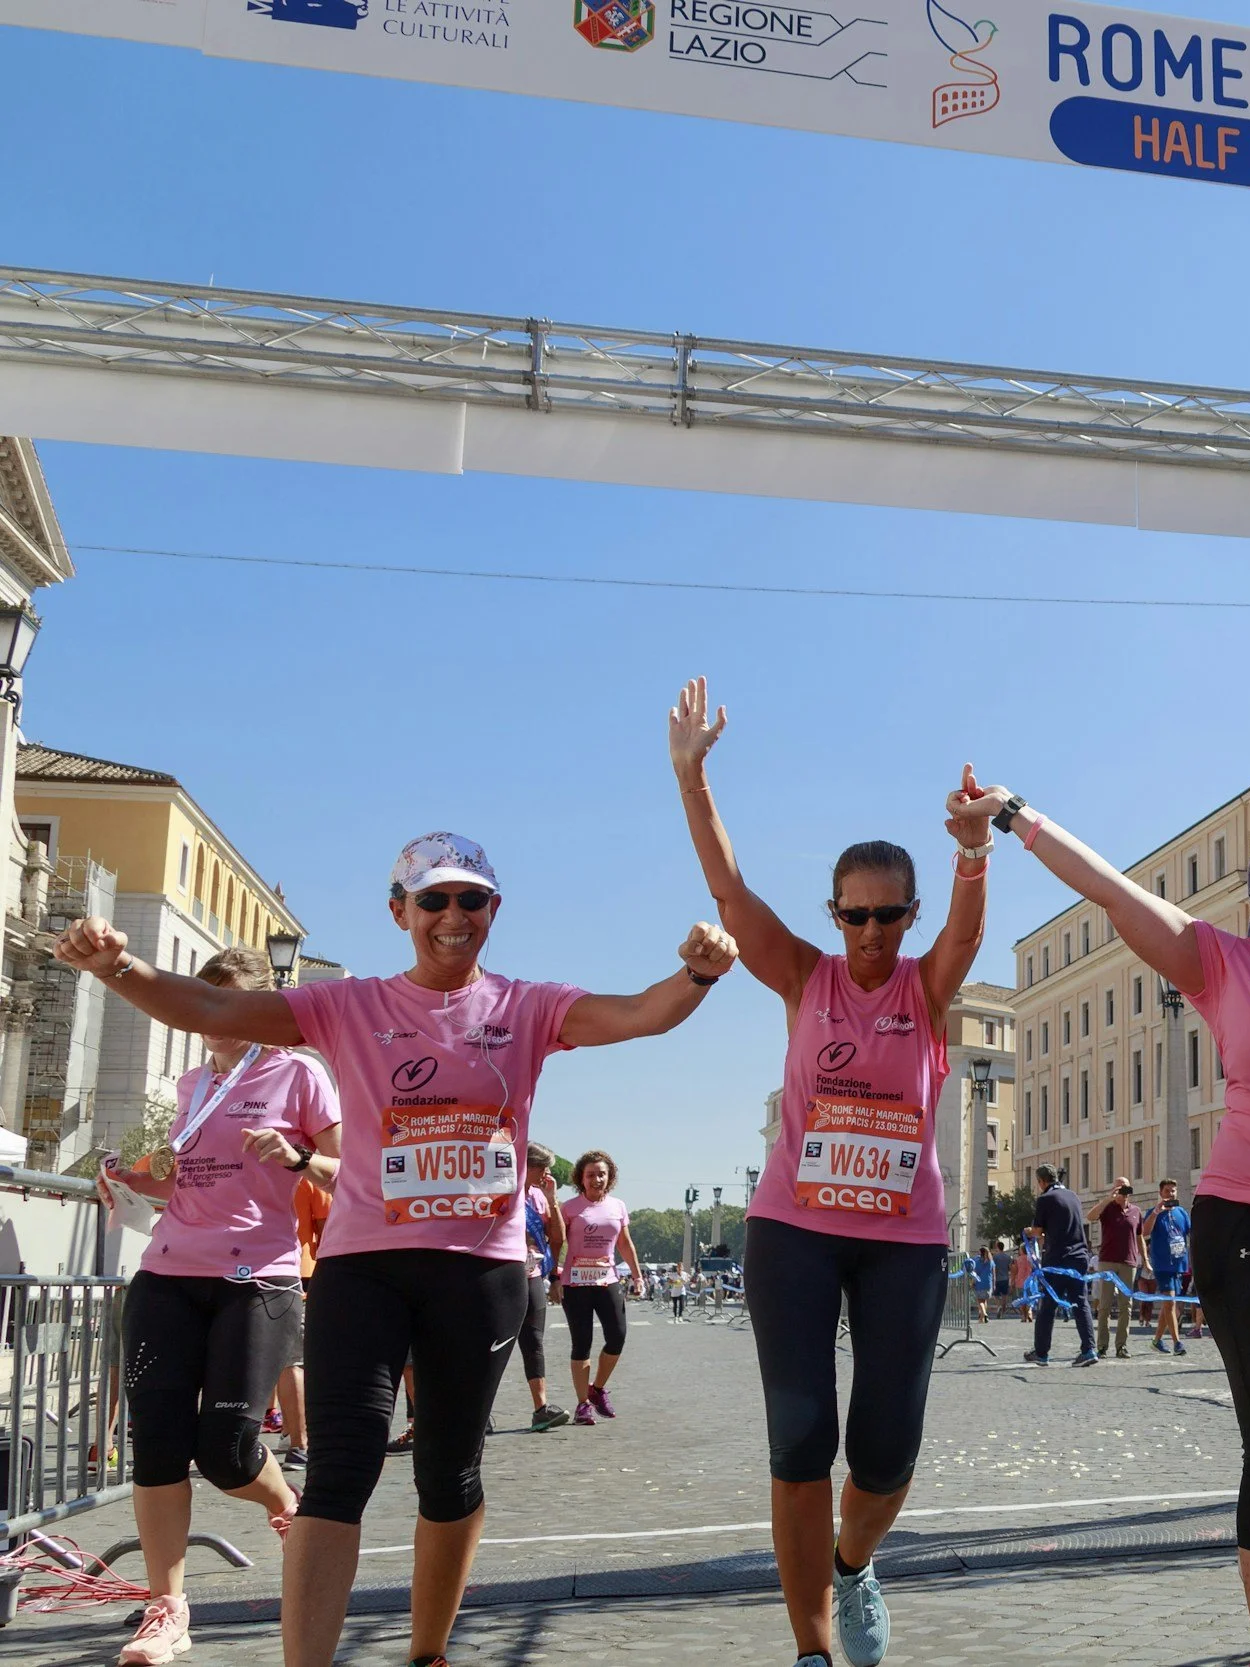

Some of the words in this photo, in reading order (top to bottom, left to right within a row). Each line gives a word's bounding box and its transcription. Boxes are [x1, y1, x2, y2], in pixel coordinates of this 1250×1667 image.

[413, 1, 510, 27] ATTIVITÀ
[671, 0, 812, 38] REGIONE
[383, 19, 509, 49] CULTURALI
[669, 31, 767, 64] LAZIO
[1048, 13, 1249, 109] ROME
[1134, 114, 1240, 171] HALF
[816, 1074, 872, 1090] Fondazione
[816, 1085, 857, 1098] Umberto
[859, 1090, 904, 1101] Veronesi
[243, 1101, 268, 1109] PINK
[391, 1095, 458, 1106] Fondazione
[411, 1115, 436, 1127] ROME
[438, 1113, 460, 1124] HALF
[462, 1113, 499, 1125] MARATHO
[831, 1116, 844, 1125] VIA
[846, 1117, 869, 1128] PACIS
[875, 1121, 918, 1135] 23.09.2018
[832, 1105, 854, 1115] ROME
[855, 1107, 875, 1118] HALF
[876, 1110, 919, 1124] MARATHON
[411, 1128, 426, 1137] VIA
[428, 1124, 455, 1135] PACIS
[206, 1162, 243, 1171] Veronesi
[415, 1143, 486, 1181] W505
[830, 1143, 891, 1181] W636
[818, 1187, 892, 1212] acea
